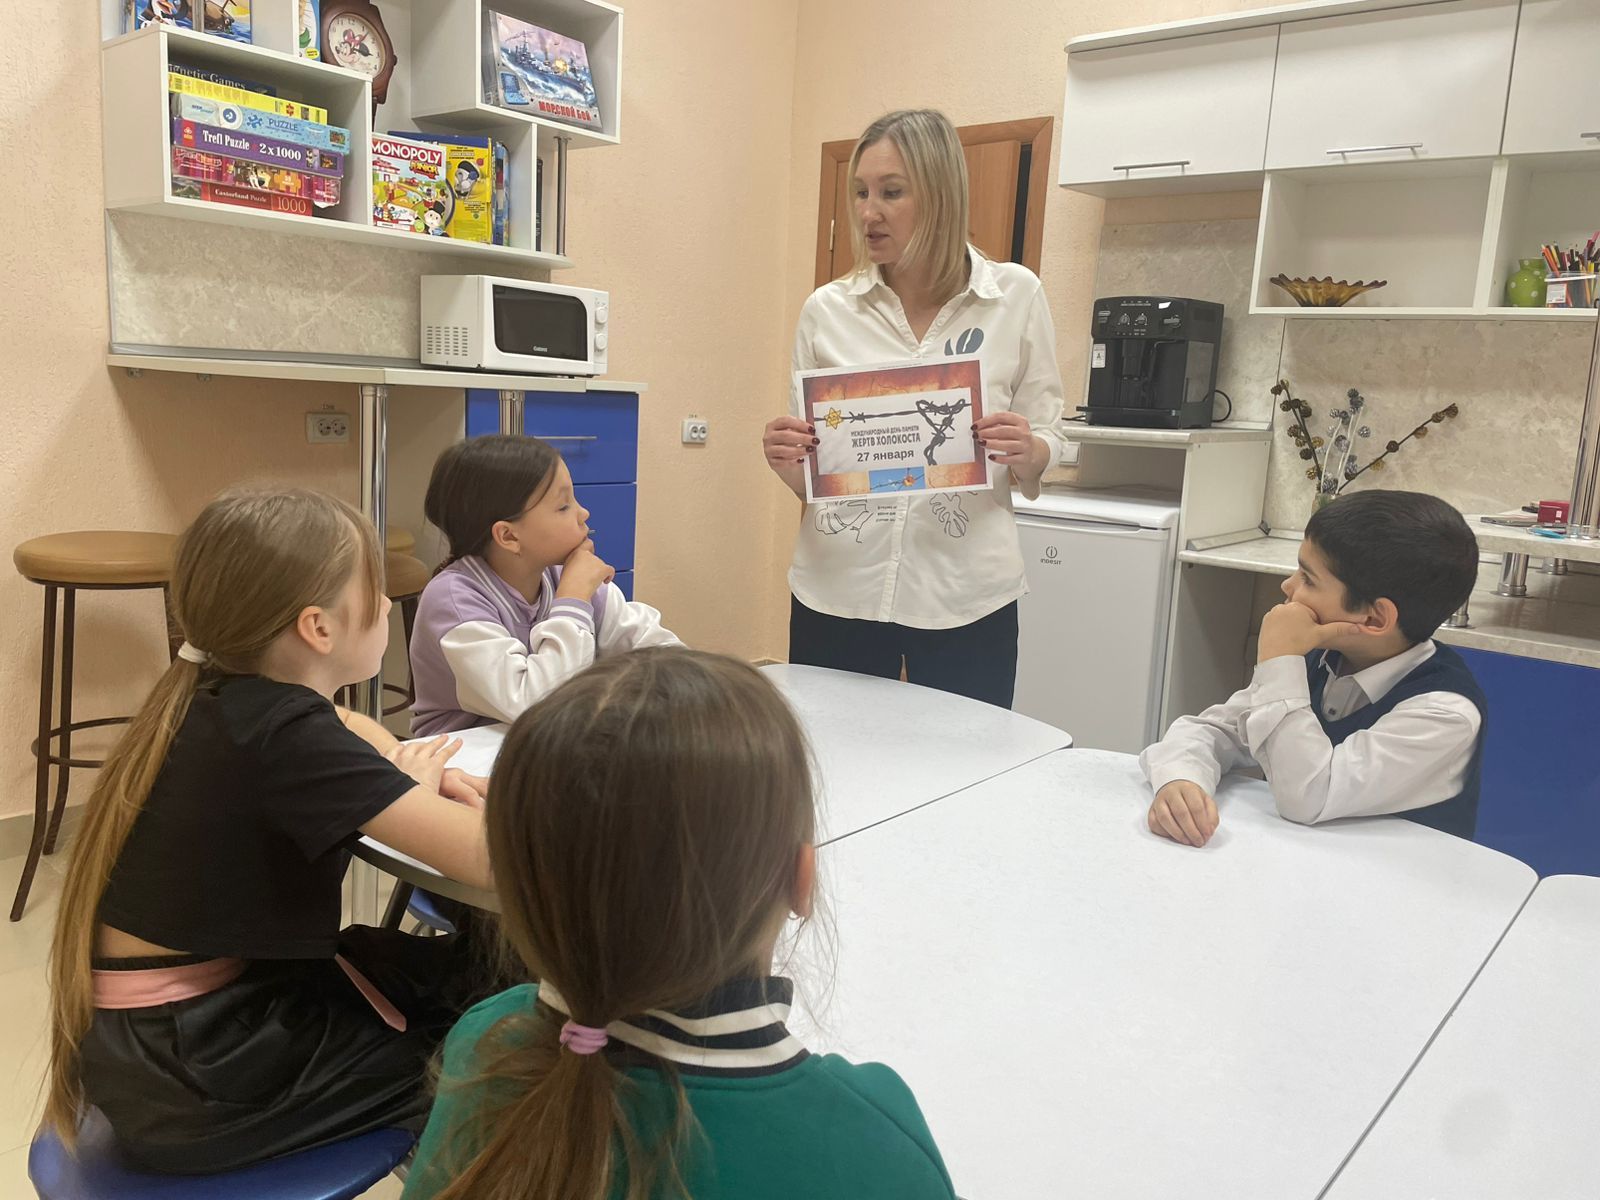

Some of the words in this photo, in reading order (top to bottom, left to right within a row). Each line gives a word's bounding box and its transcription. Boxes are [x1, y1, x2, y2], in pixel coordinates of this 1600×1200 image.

[210, 73, 246, 90] Games
[268, 118, 299, 132] PUZZLE
[203, 129, 223, 145] Trefl
[224, 134, 250, 151] Puzzle
[372, 139, 441, 164] MONOPOLY
[278, 196, 307, 214] 1000
[852, 436, 875, 448] ЖЕРТВ
[876, 433, 921, 446] ХОЛОКОСТА
[857, 452, 870, 462] 27
[873, 449, 914, 461] января
